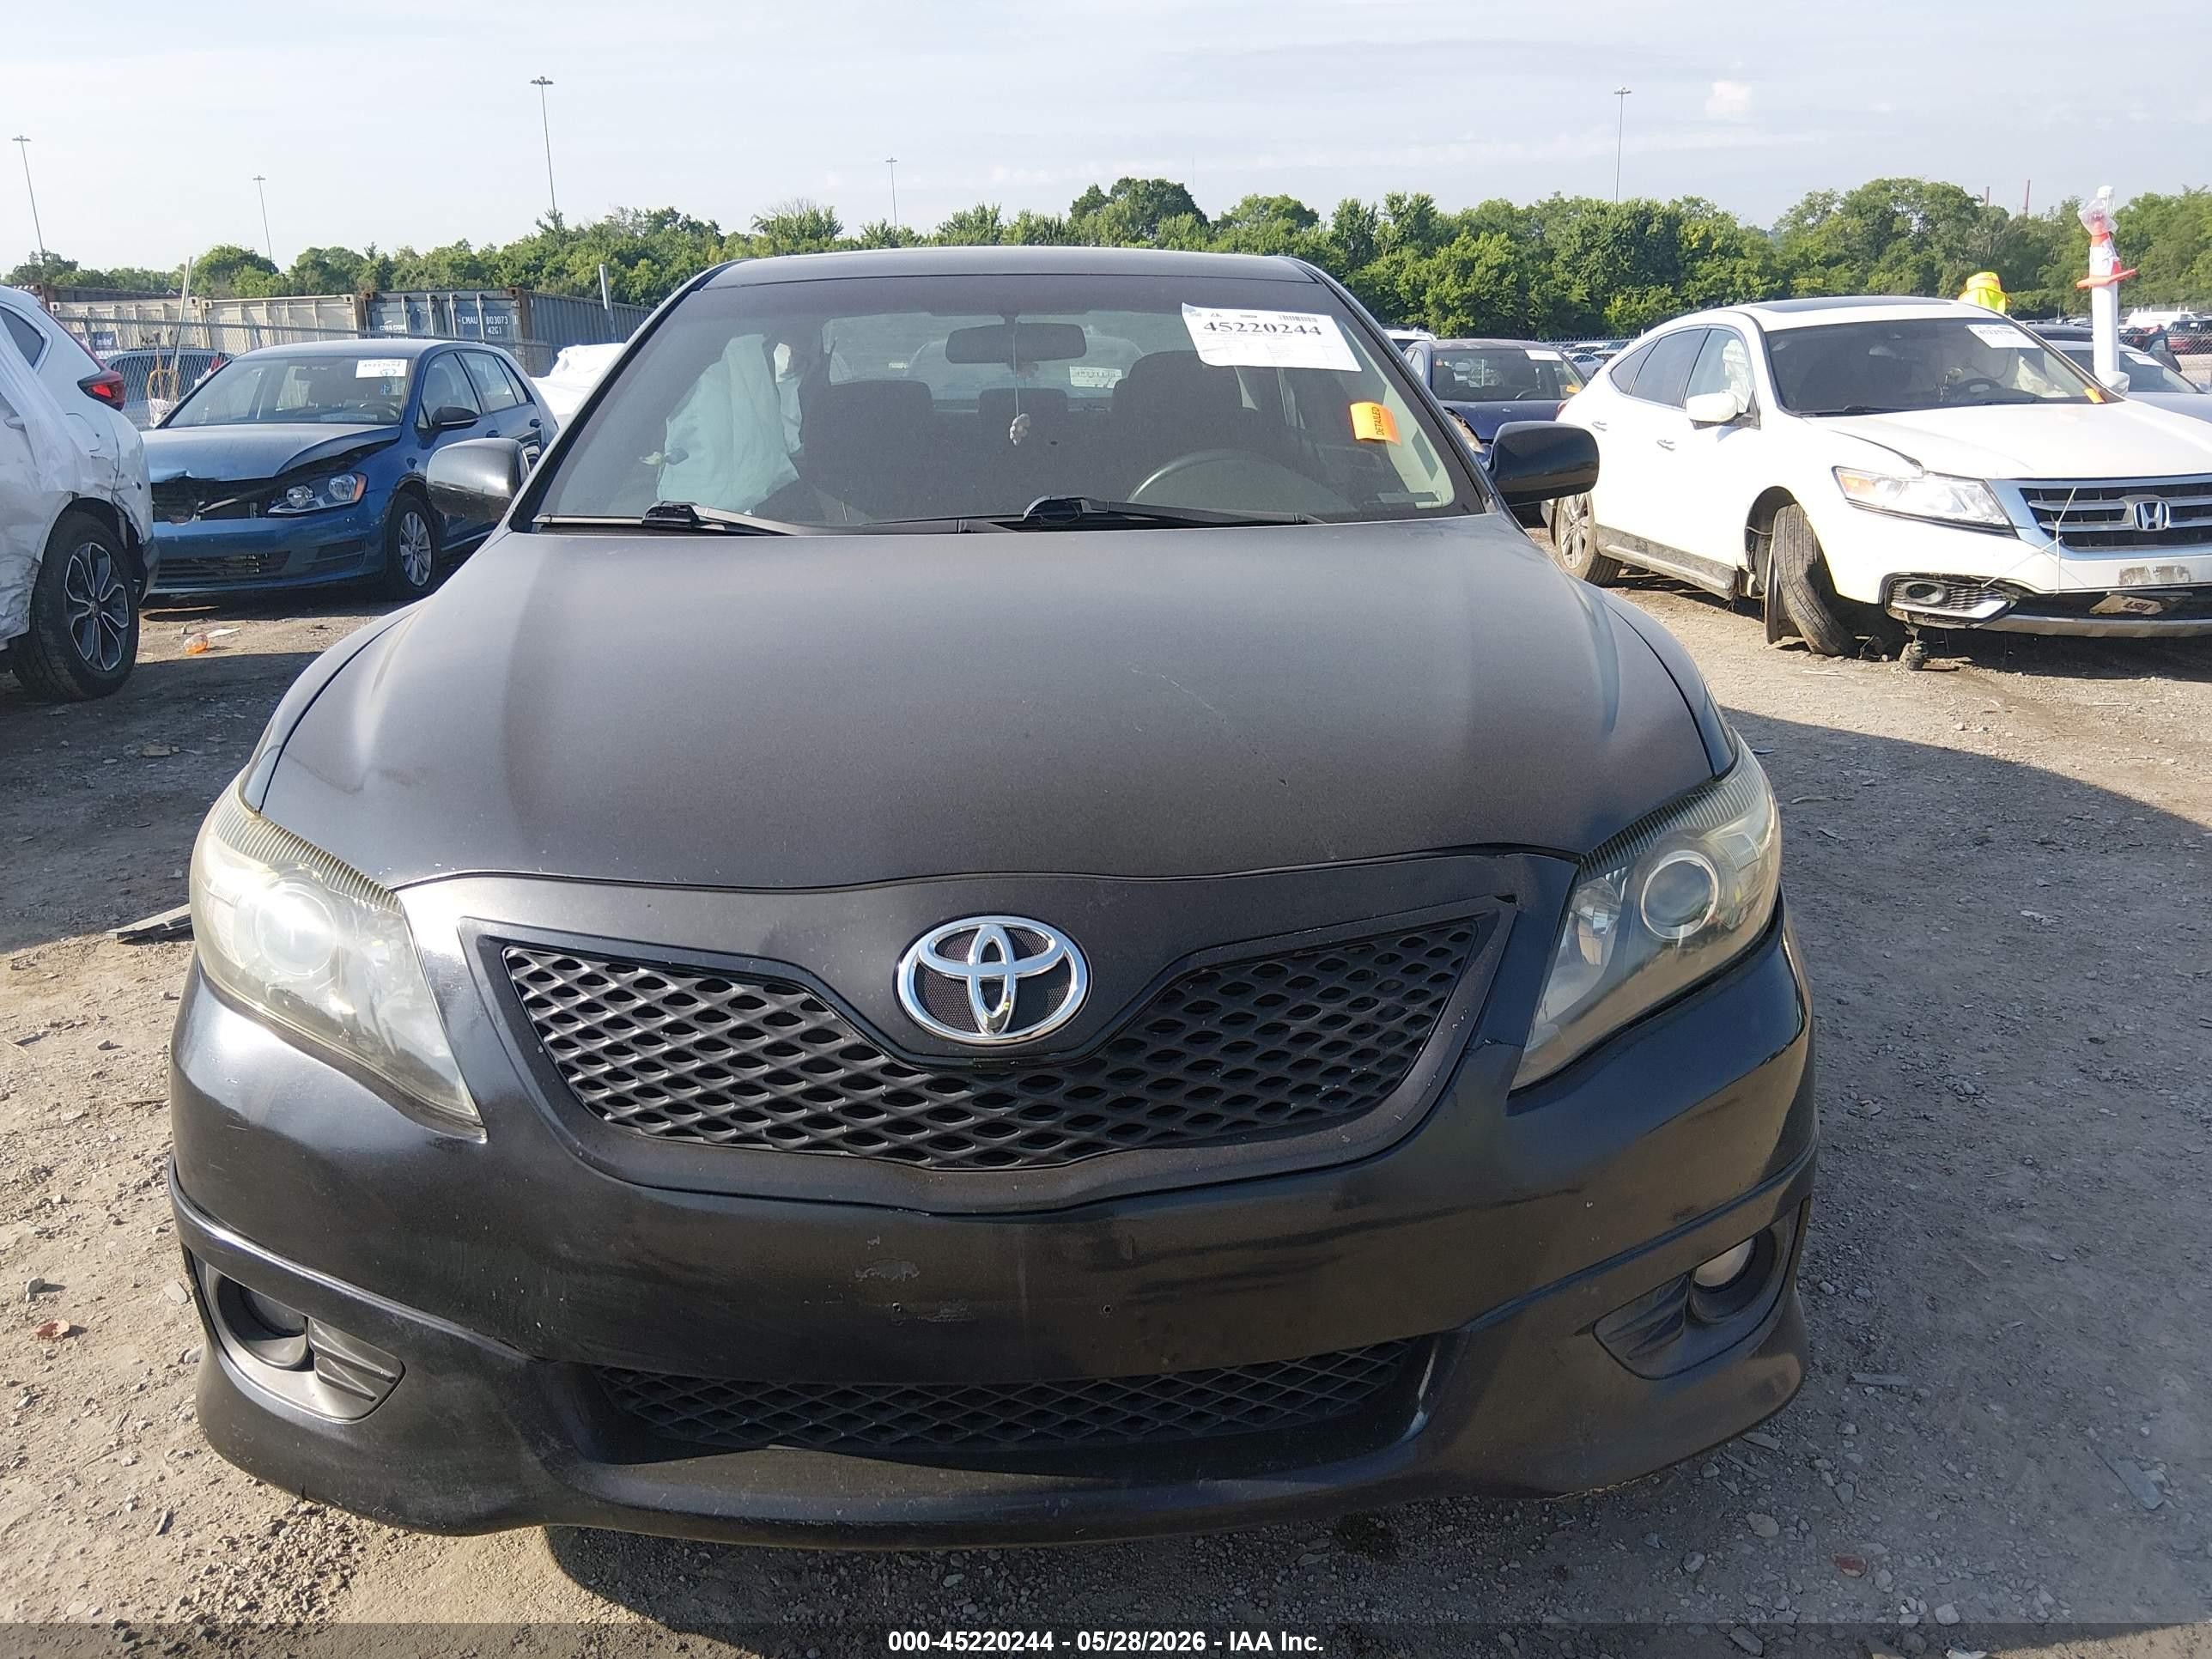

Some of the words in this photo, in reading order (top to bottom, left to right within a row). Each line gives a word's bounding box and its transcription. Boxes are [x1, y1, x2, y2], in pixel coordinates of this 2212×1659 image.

[461, 315, 478, 325] CMAU
[1203, 321, 1322, 336] 45220244
[1370, 406, 1385, 436] DETAILED
